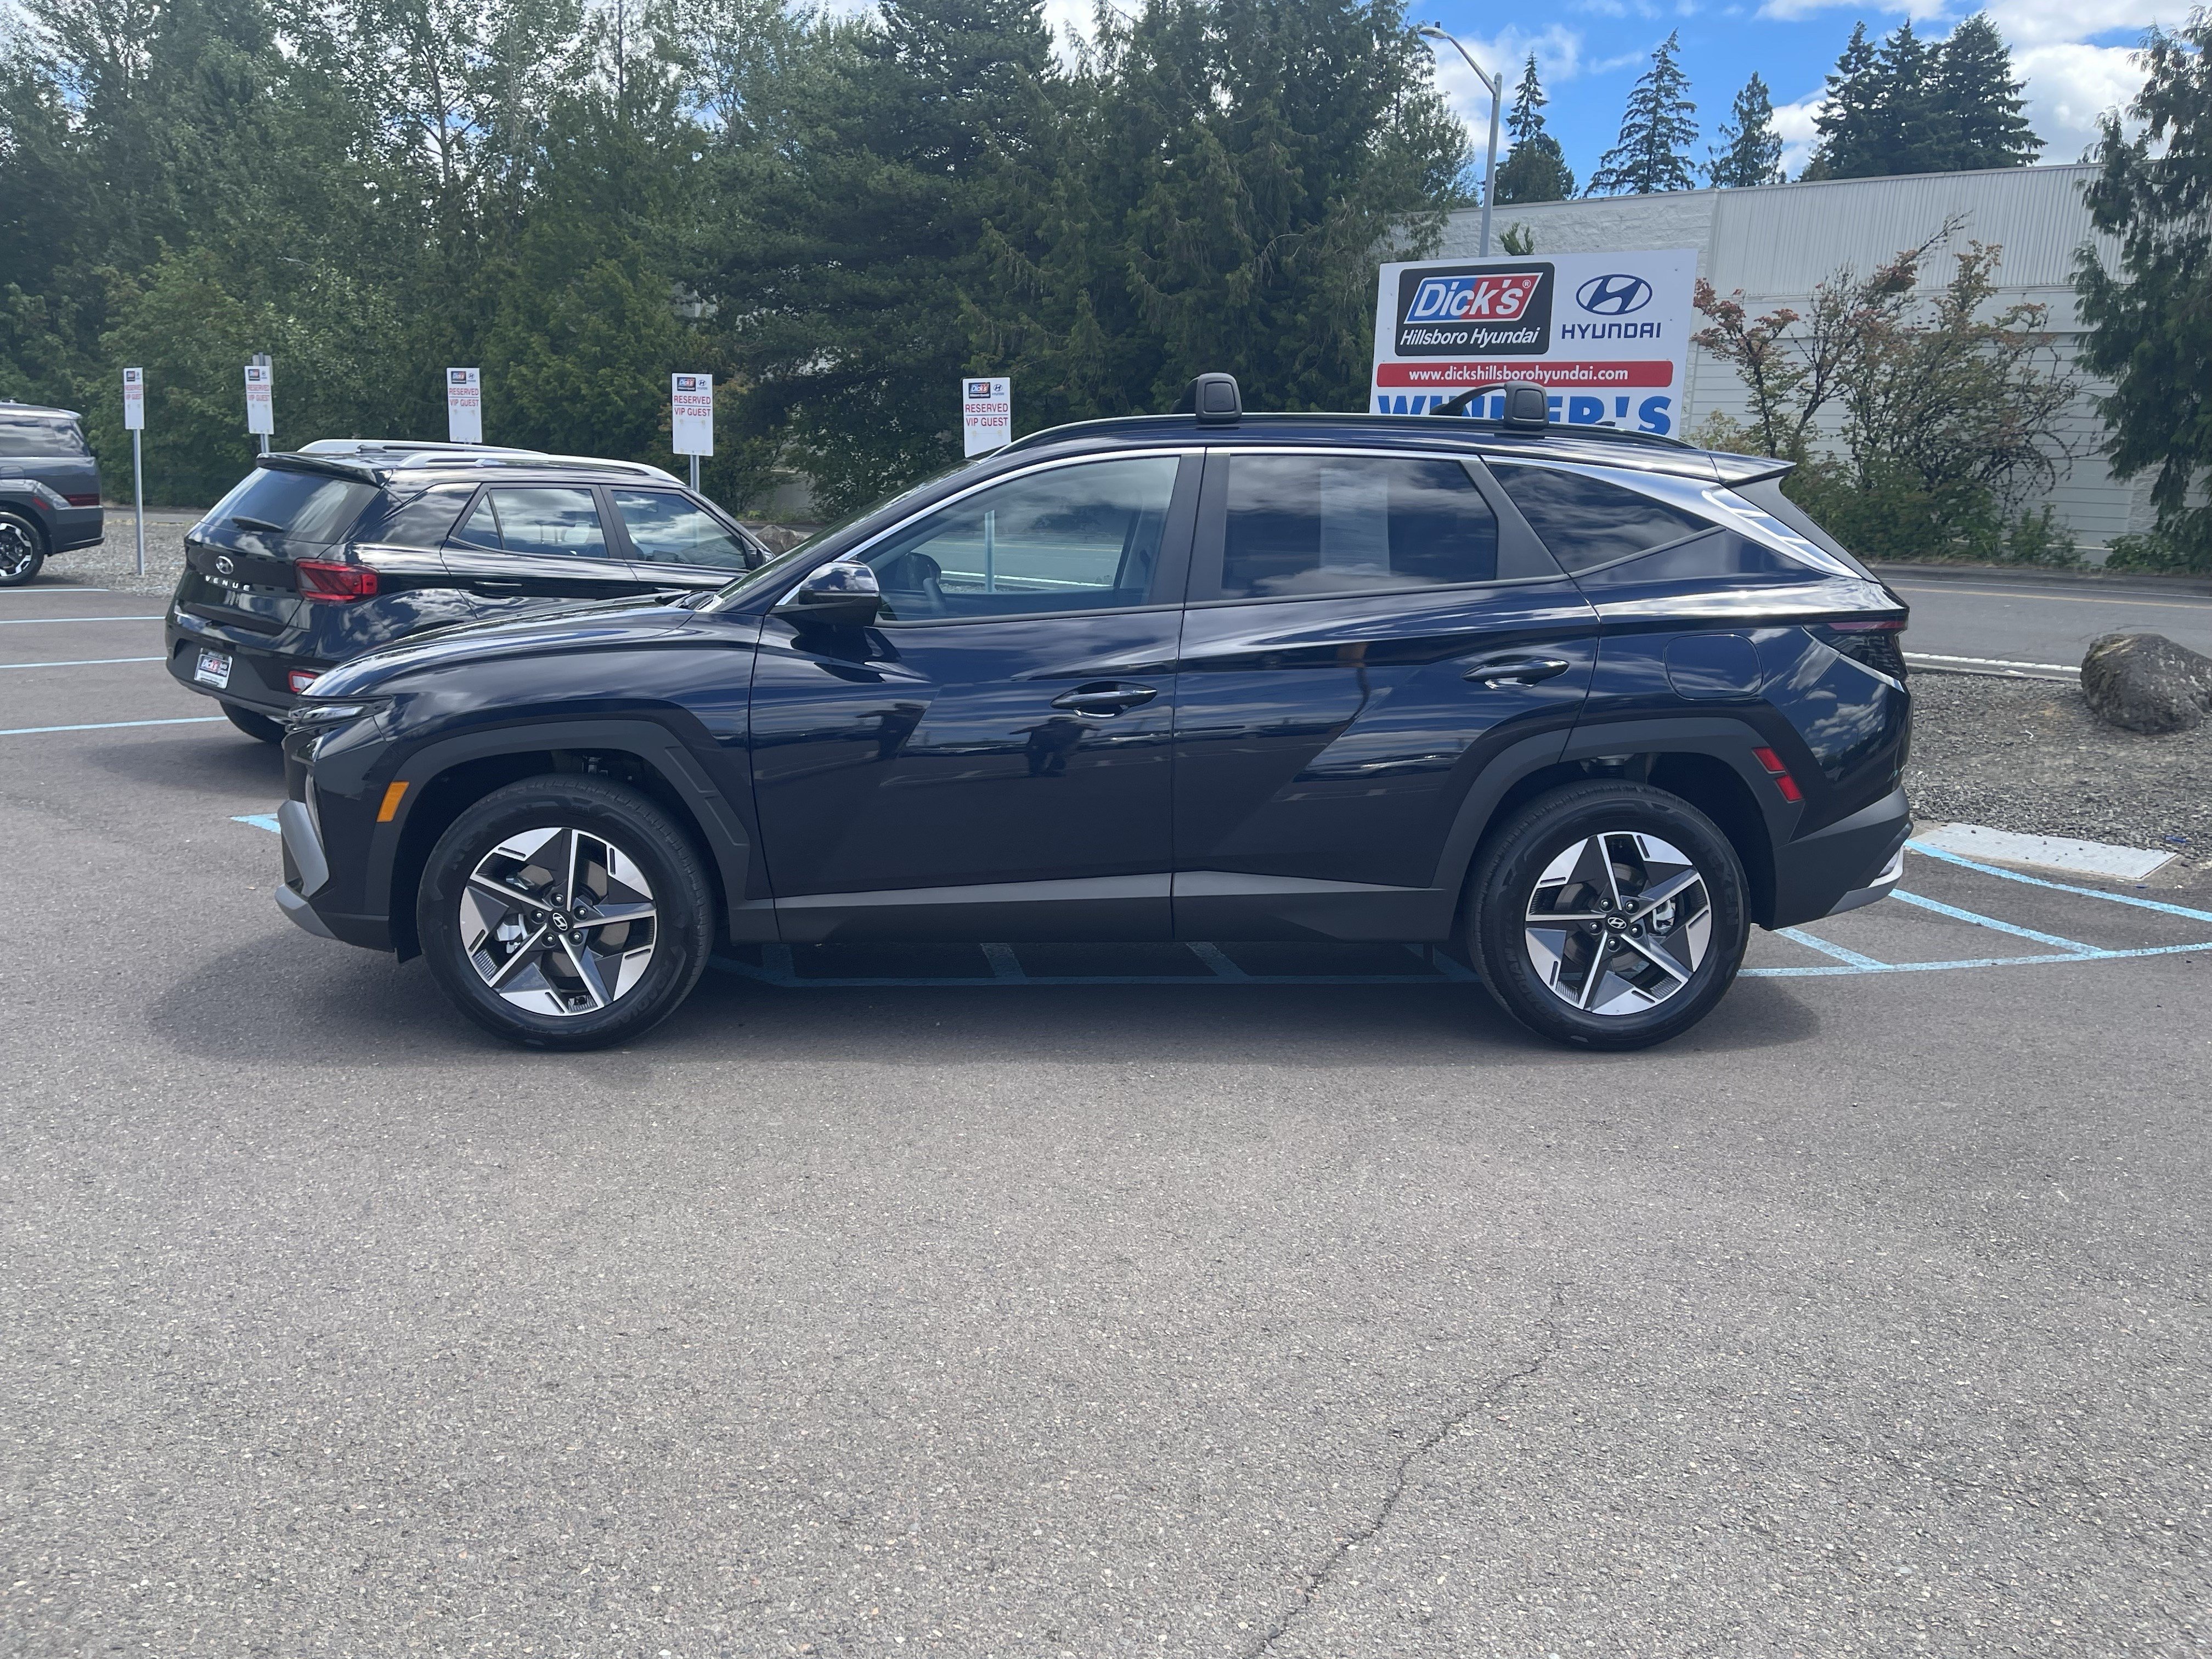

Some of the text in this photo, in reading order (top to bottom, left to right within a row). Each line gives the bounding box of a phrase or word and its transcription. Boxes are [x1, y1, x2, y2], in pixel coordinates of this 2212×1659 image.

[1400, 327, 1541, 348] Hillsboro Hyundai
[1561, 322, 1661, 340] HYUNDAI
[1409, 364, 1629, 384] www.dickshillsborohyundai.com
[674, 395, 711, 405] RESERVED
[674, 407, 711, 417] VIP GUEST
[965, 403, 1008, 413] RESERVED
[966, 417, 1008, 426] VIP GUEST
[205, 575, 250, 592] VENUE
